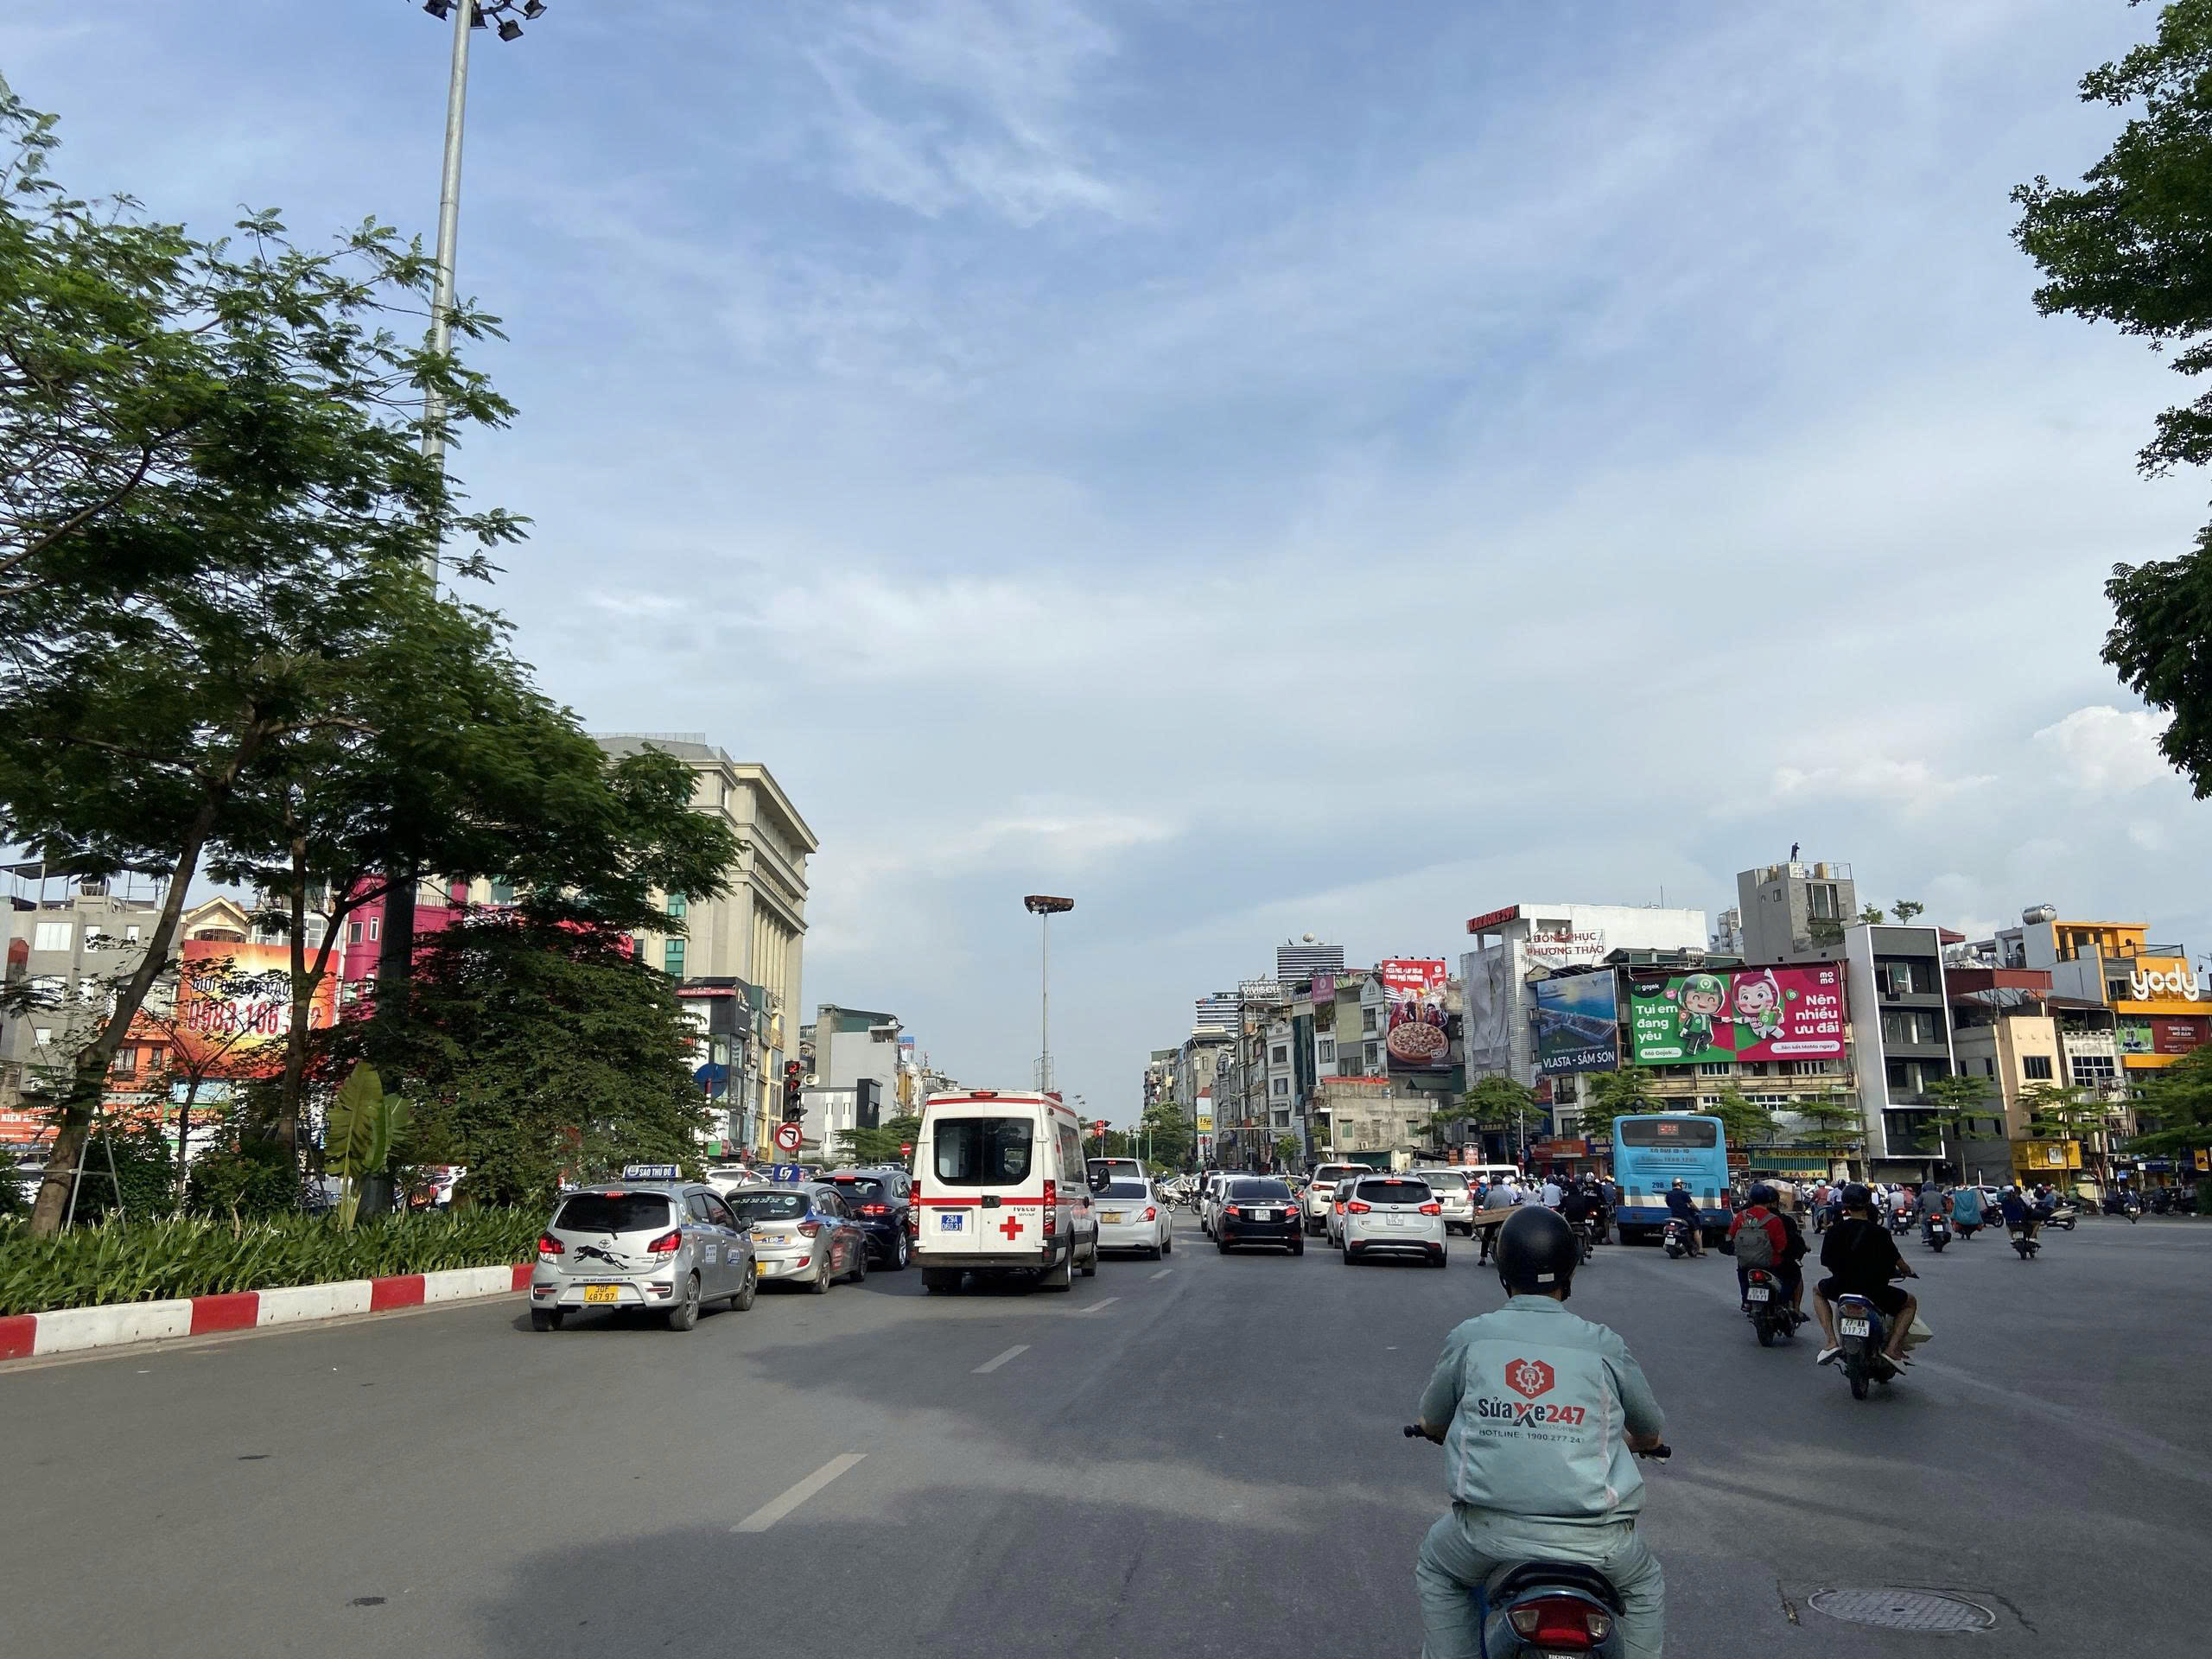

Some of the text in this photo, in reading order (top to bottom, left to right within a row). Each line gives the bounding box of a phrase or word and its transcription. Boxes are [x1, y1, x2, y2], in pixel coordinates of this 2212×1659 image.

[2130, 963, 2199, 1001] yody
[1806, 995, 1837, 1005] Nên
[1636, 1004, 1678, 1016] Tụi em
[1796, 1007, 1838, 1020] nhiều
[1637, 1019, 1669, 1029] đang
[1795, 1021, 1840, 1034] ưu đãi
[1638, 1031, 1662, 1044] yêu
[1543, 1057, 1571, 1068] VLASTA
[639, 1167, 652, 1177] SAO
